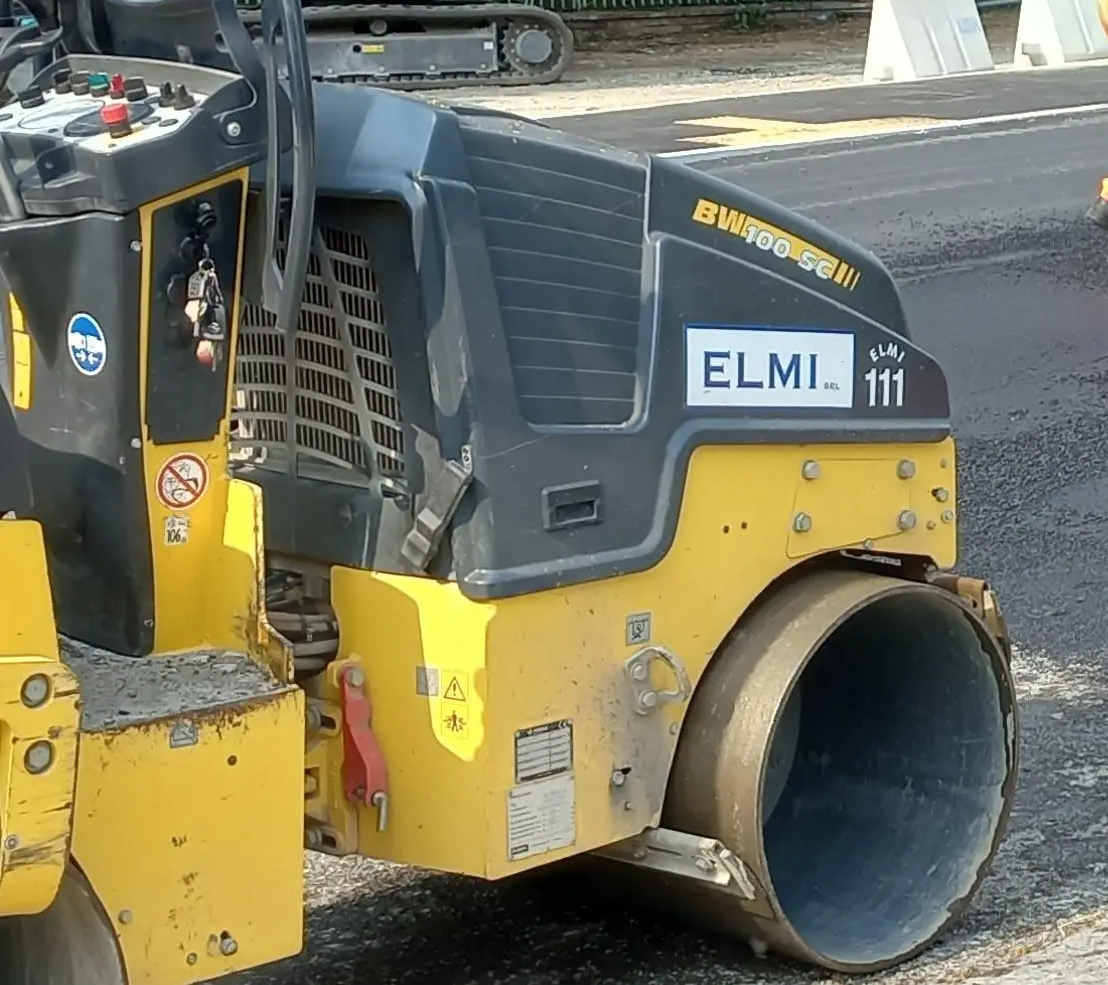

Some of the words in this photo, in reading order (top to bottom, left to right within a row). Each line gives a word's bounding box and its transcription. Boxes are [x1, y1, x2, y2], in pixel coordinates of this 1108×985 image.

[703, 350, 818, 390] ELMI
[870, 342, 906, 363] ELMI
[864, 367, 905, 408] 111
